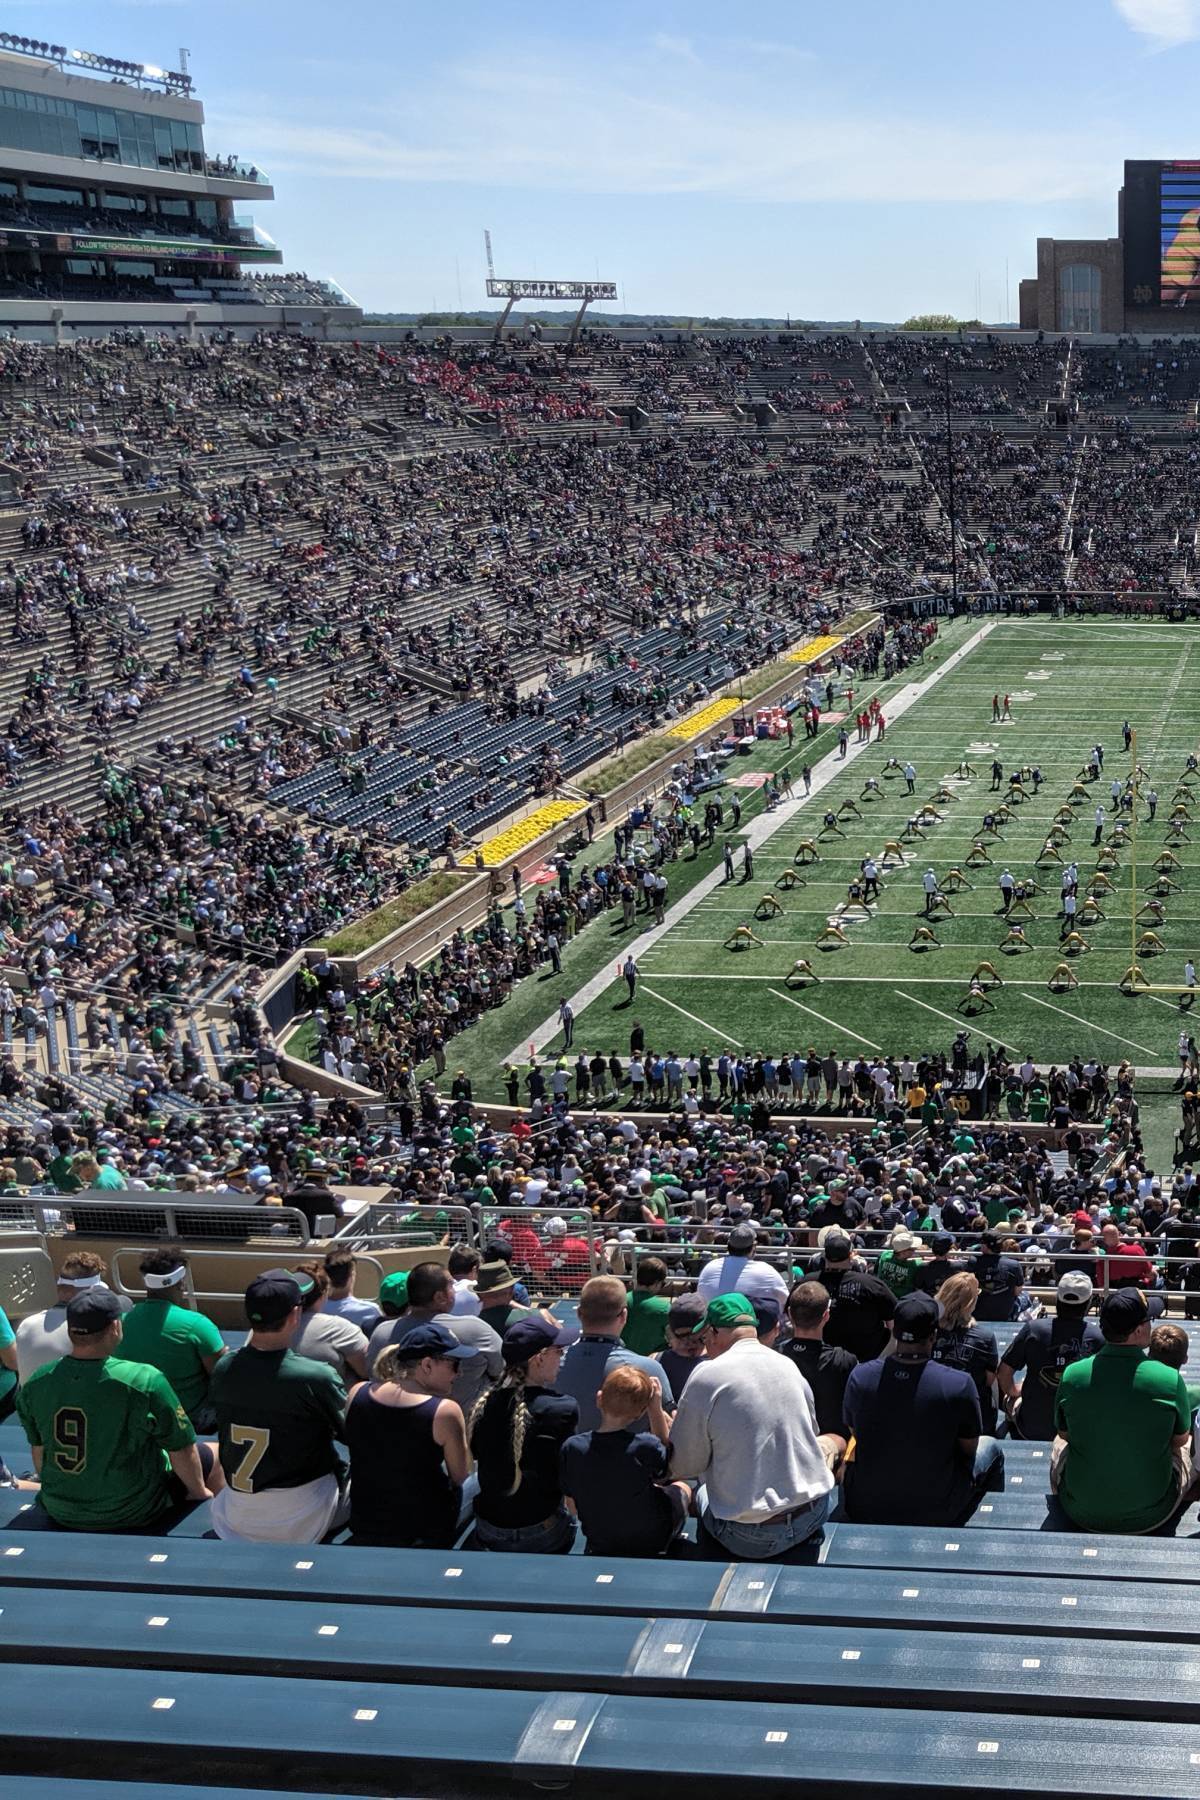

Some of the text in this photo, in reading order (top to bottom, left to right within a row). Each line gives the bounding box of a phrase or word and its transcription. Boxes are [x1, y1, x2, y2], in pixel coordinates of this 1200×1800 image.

[801, 1133, 809, 1144] 5
[952, 1199, 966, 1215] 6
[933, 1350, 942, 1359] 19
[1056, 1357, 1066, 1366] 19
[54, 1407, 87, 1475] 9
[231, 1423, 270, 1493] 7
